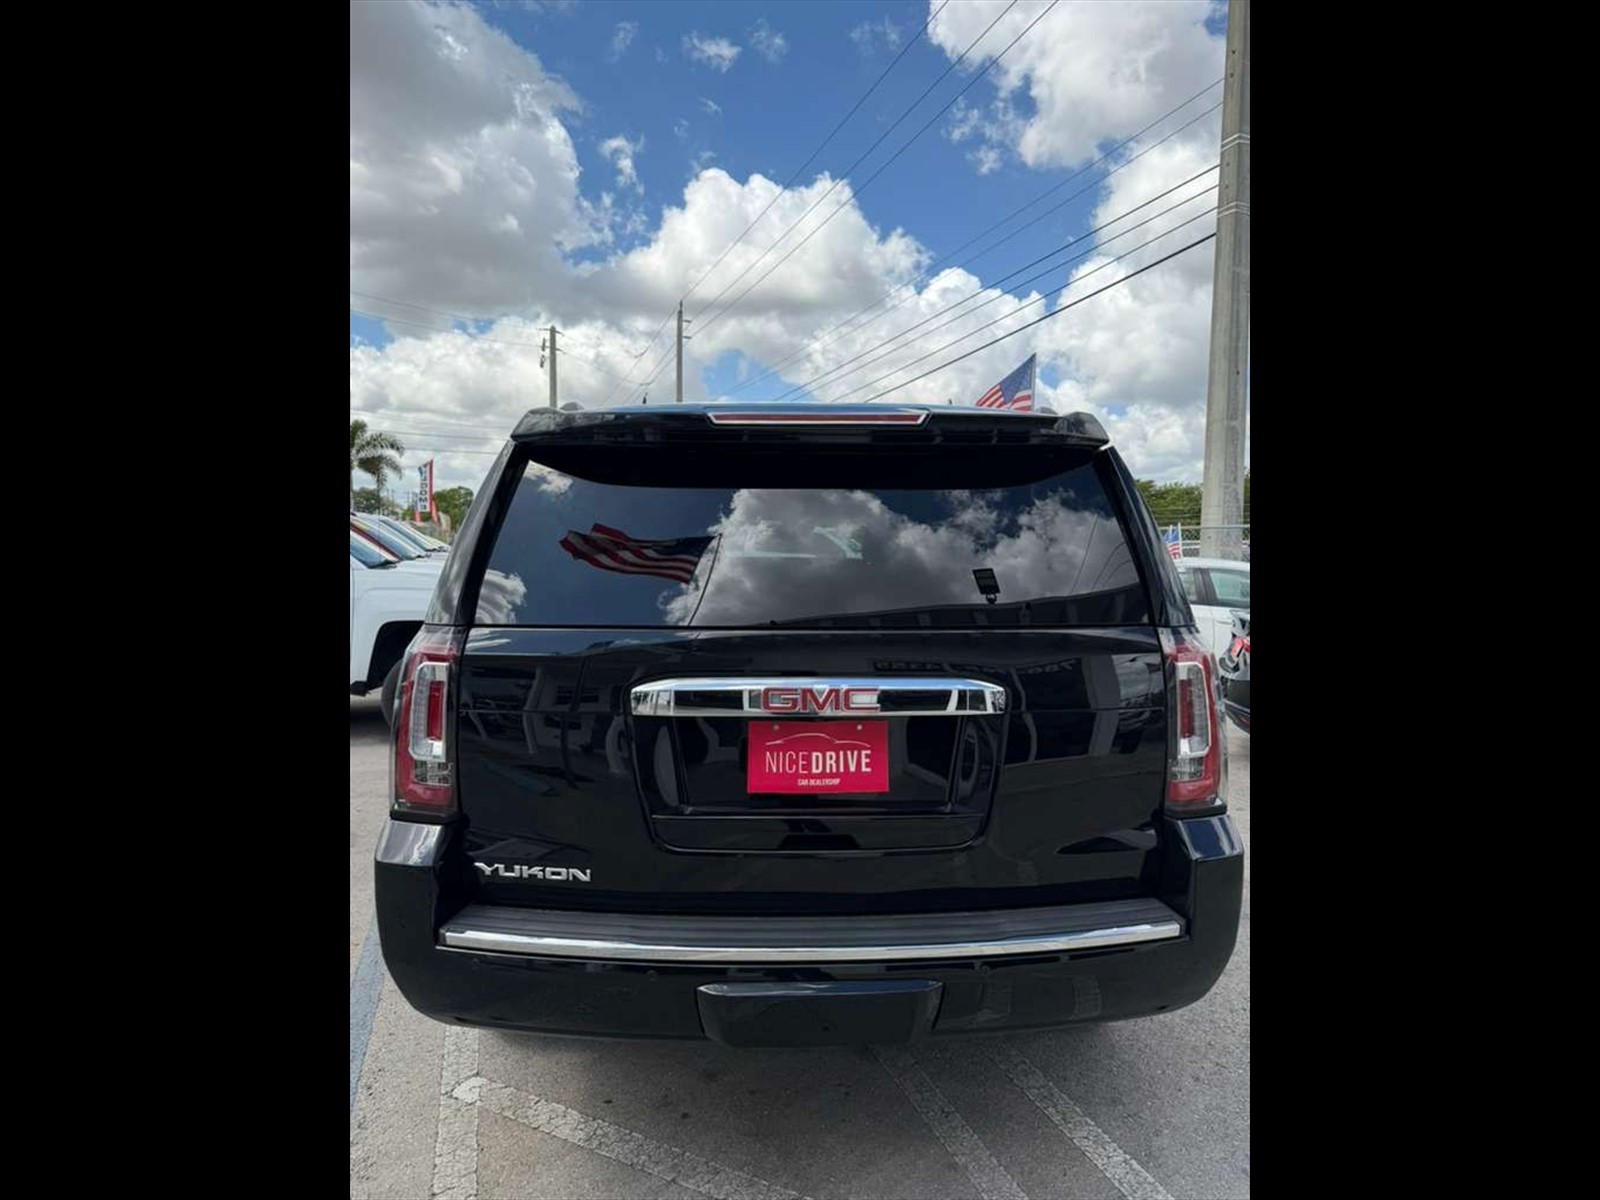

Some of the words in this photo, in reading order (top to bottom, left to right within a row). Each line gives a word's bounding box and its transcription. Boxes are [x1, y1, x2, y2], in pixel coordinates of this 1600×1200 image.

[761, 686, 881, 713] GMC
[797, 778, 808, 786] CAR
[809, 777, 841, 786] DEALERSHIP
[474, 862, 591, 882] YUKON
